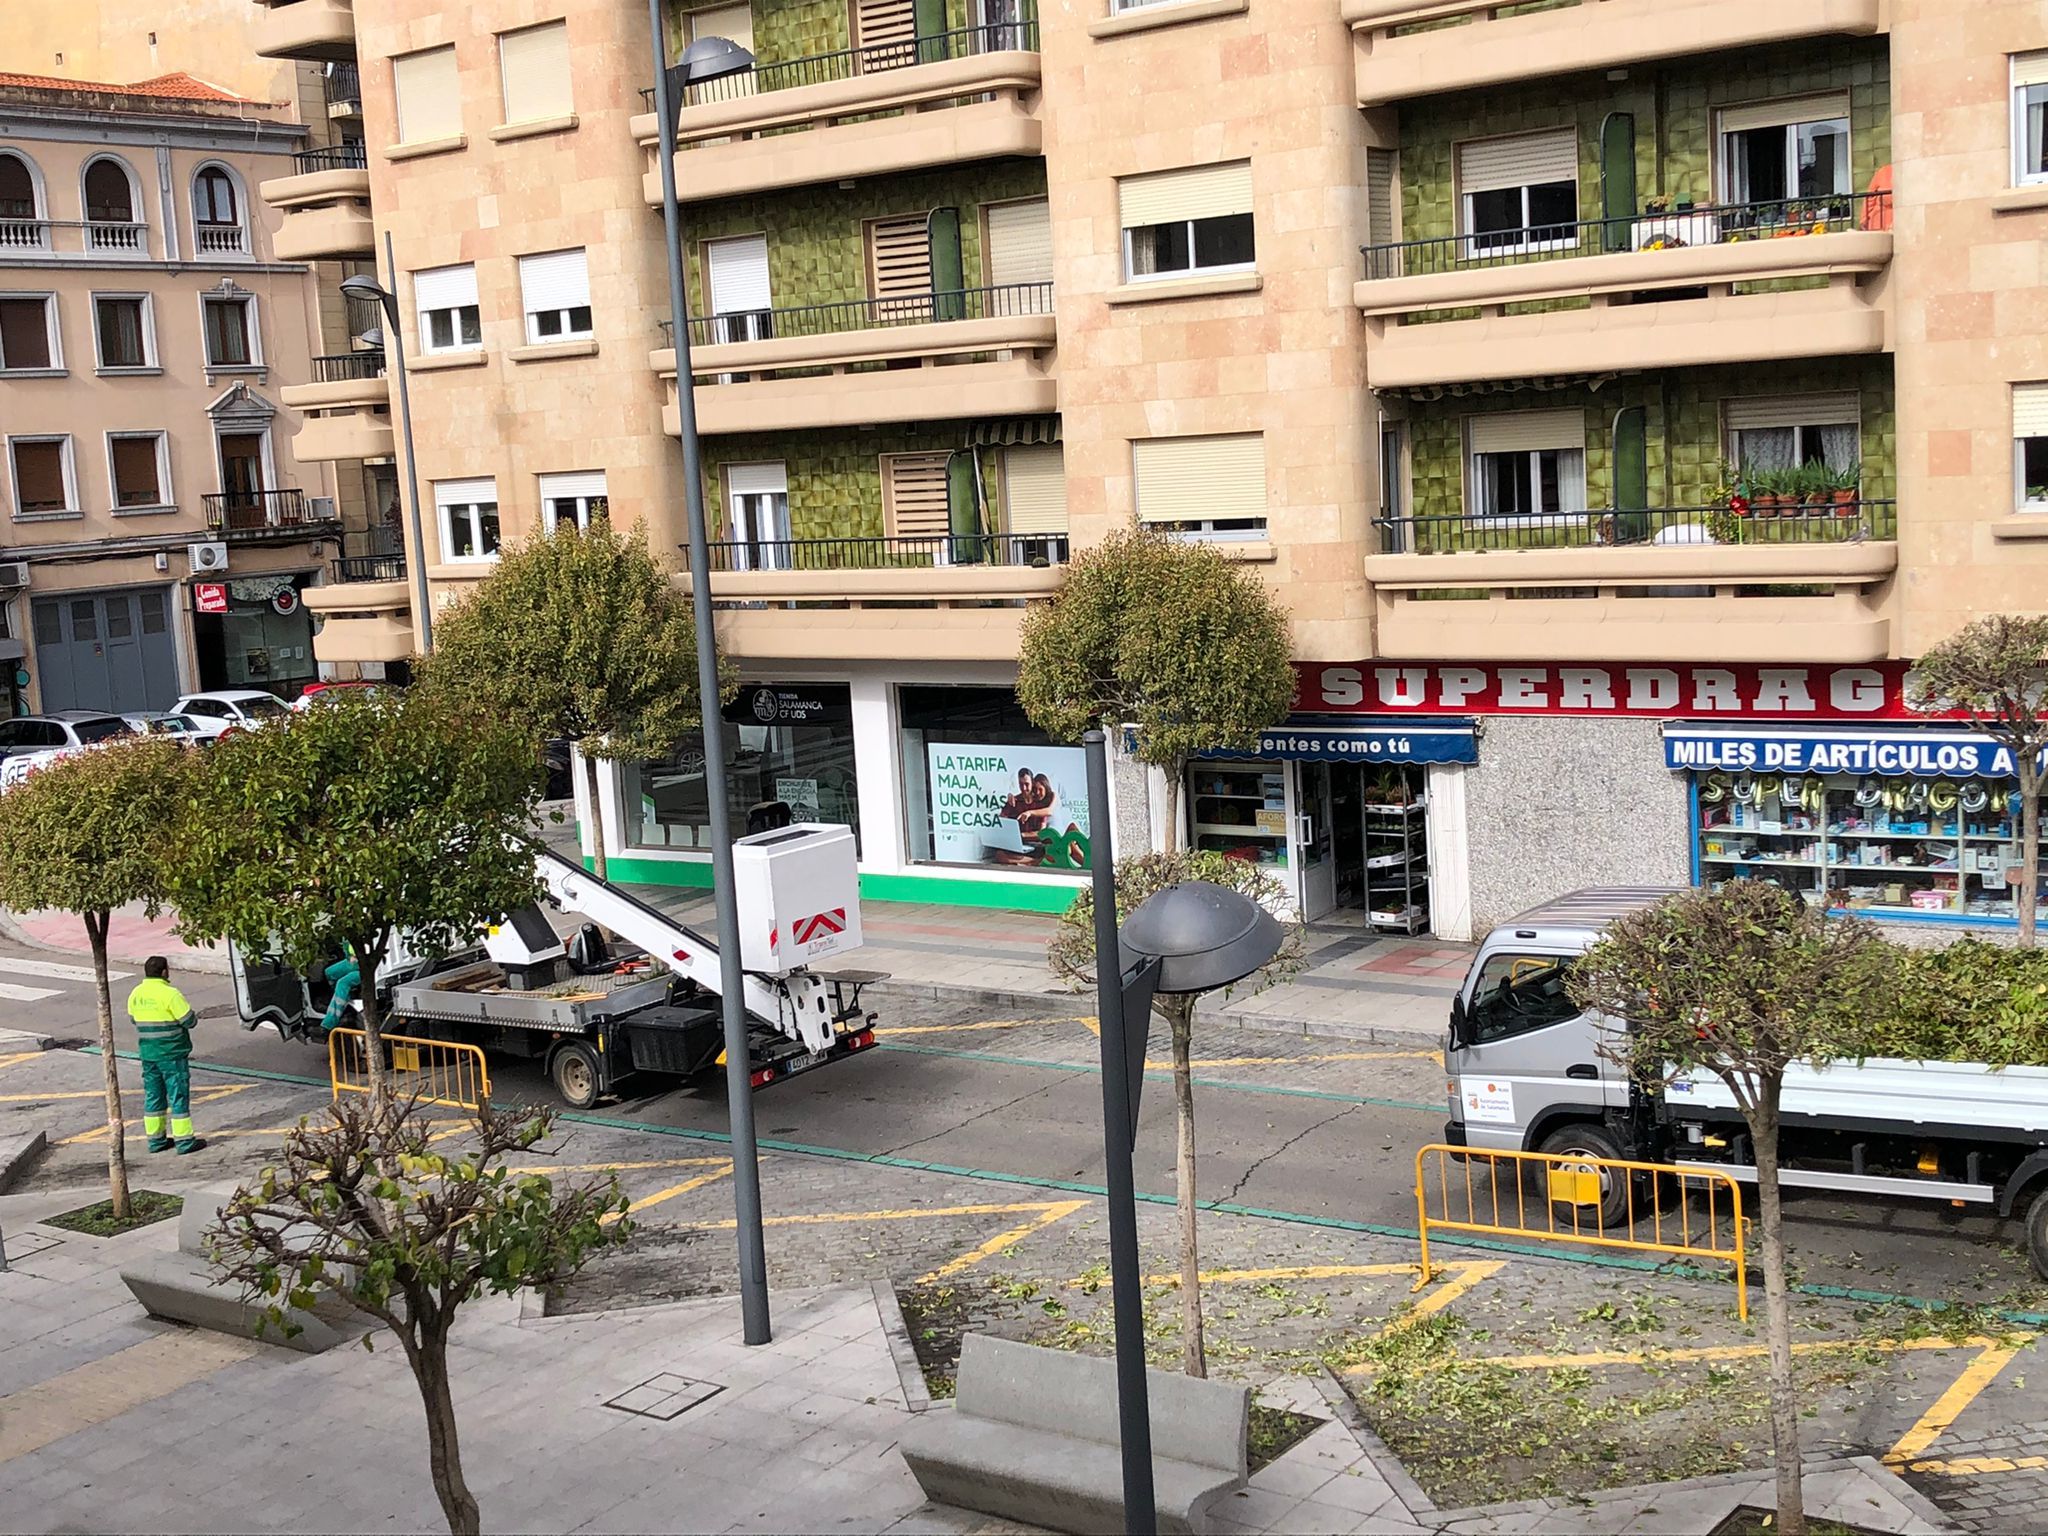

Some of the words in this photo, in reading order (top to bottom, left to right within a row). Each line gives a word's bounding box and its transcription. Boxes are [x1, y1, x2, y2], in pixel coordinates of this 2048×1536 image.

[779, 701, 823, 710] SALAMANCA
[780, 710, 789, 719] CF
[790, 710, 806, 719] UDS
[1327, 740, 1382, 753] como
[1388, 737, 1410, 754] tú
[937, 755, 955, 769] LA
[957, 757, 1007, 772] TARIFA
[1673, 741, 1757, 765] MILES
[1765, 744, 1801, 766] DE
[1810, 740, 1979, 770] ARTÍCULOS
[1991, 747, 2014, 772] A
[938, 774, 982, 792] MAJA,
[939, 793, 974, 808] UNO
[977, 790, 1006, 809] MÁS
[940, 812, 960, 826] DE
[962, 811, 1002, 828] CASA
[1257, 812, 1286, 822] AFORO
